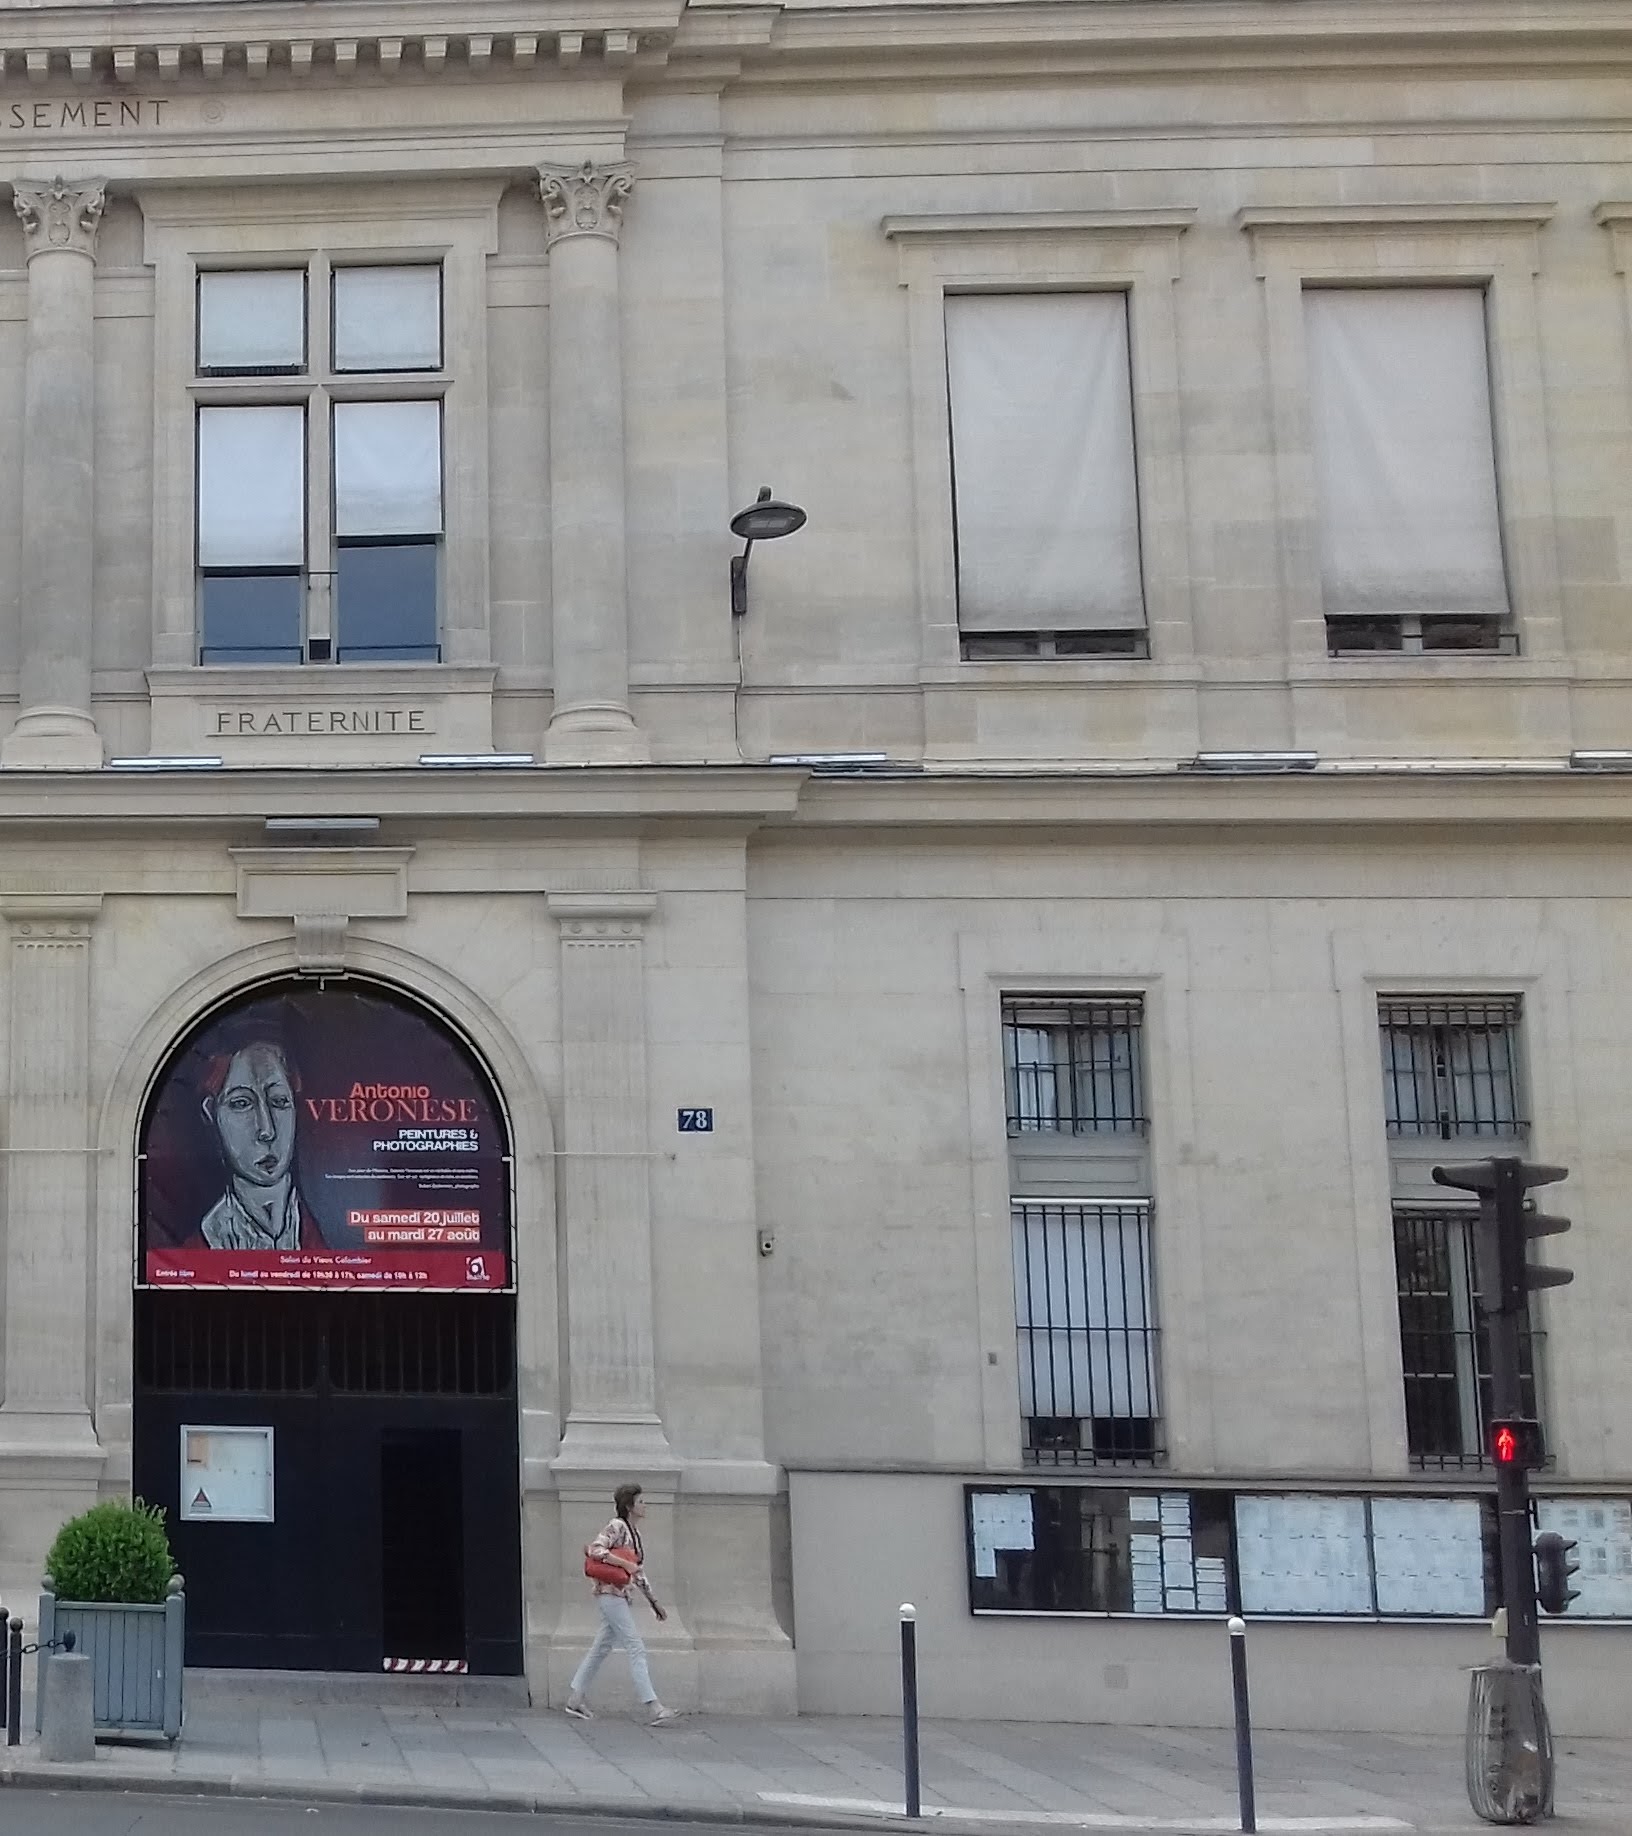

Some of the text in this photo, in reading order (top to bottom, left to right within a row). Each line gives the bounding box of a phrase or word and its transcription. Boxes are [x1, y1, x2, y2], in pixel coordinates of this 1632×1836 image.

[217, 710, 425, 733] FRATERNITE
[349, 1081, 430, 1099] Antonio
[305, 1099, 479, 1122] VERONESE
[682, 1110, 708, 1129] 78
[398, 1129, 479, 1140] PEINTURES &
[372, 1140, 479, 1151] PHOTOGRAPHIES
[350, 1211, 480, 1227] Du samedi 20 juillet
[367, 1228, 480, 1240] au mardi 27 août
